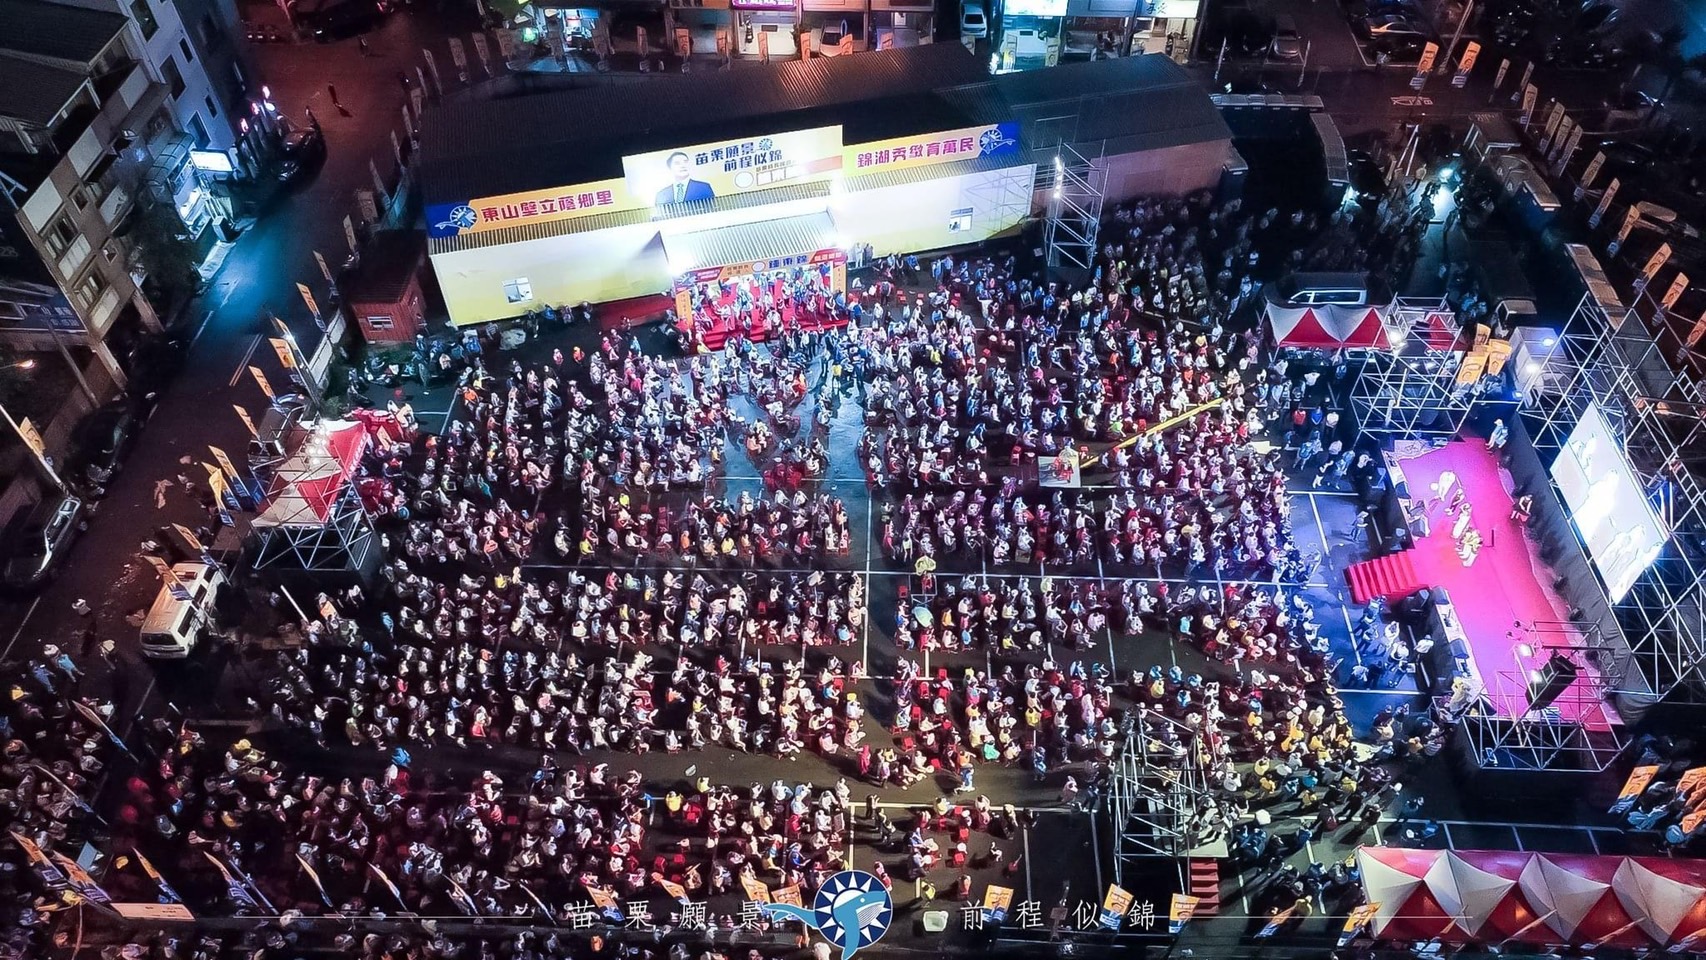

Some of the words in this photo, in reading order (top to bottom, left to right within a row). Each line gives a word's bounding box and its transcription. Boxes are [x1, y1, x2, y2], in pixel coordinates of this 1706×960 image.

[695, 141, 755, 166] 苗栗願景
[724, 149, 783, 173] 前程似錦
[481, 190, 614, 222] 東山壁立蔭鄉里
